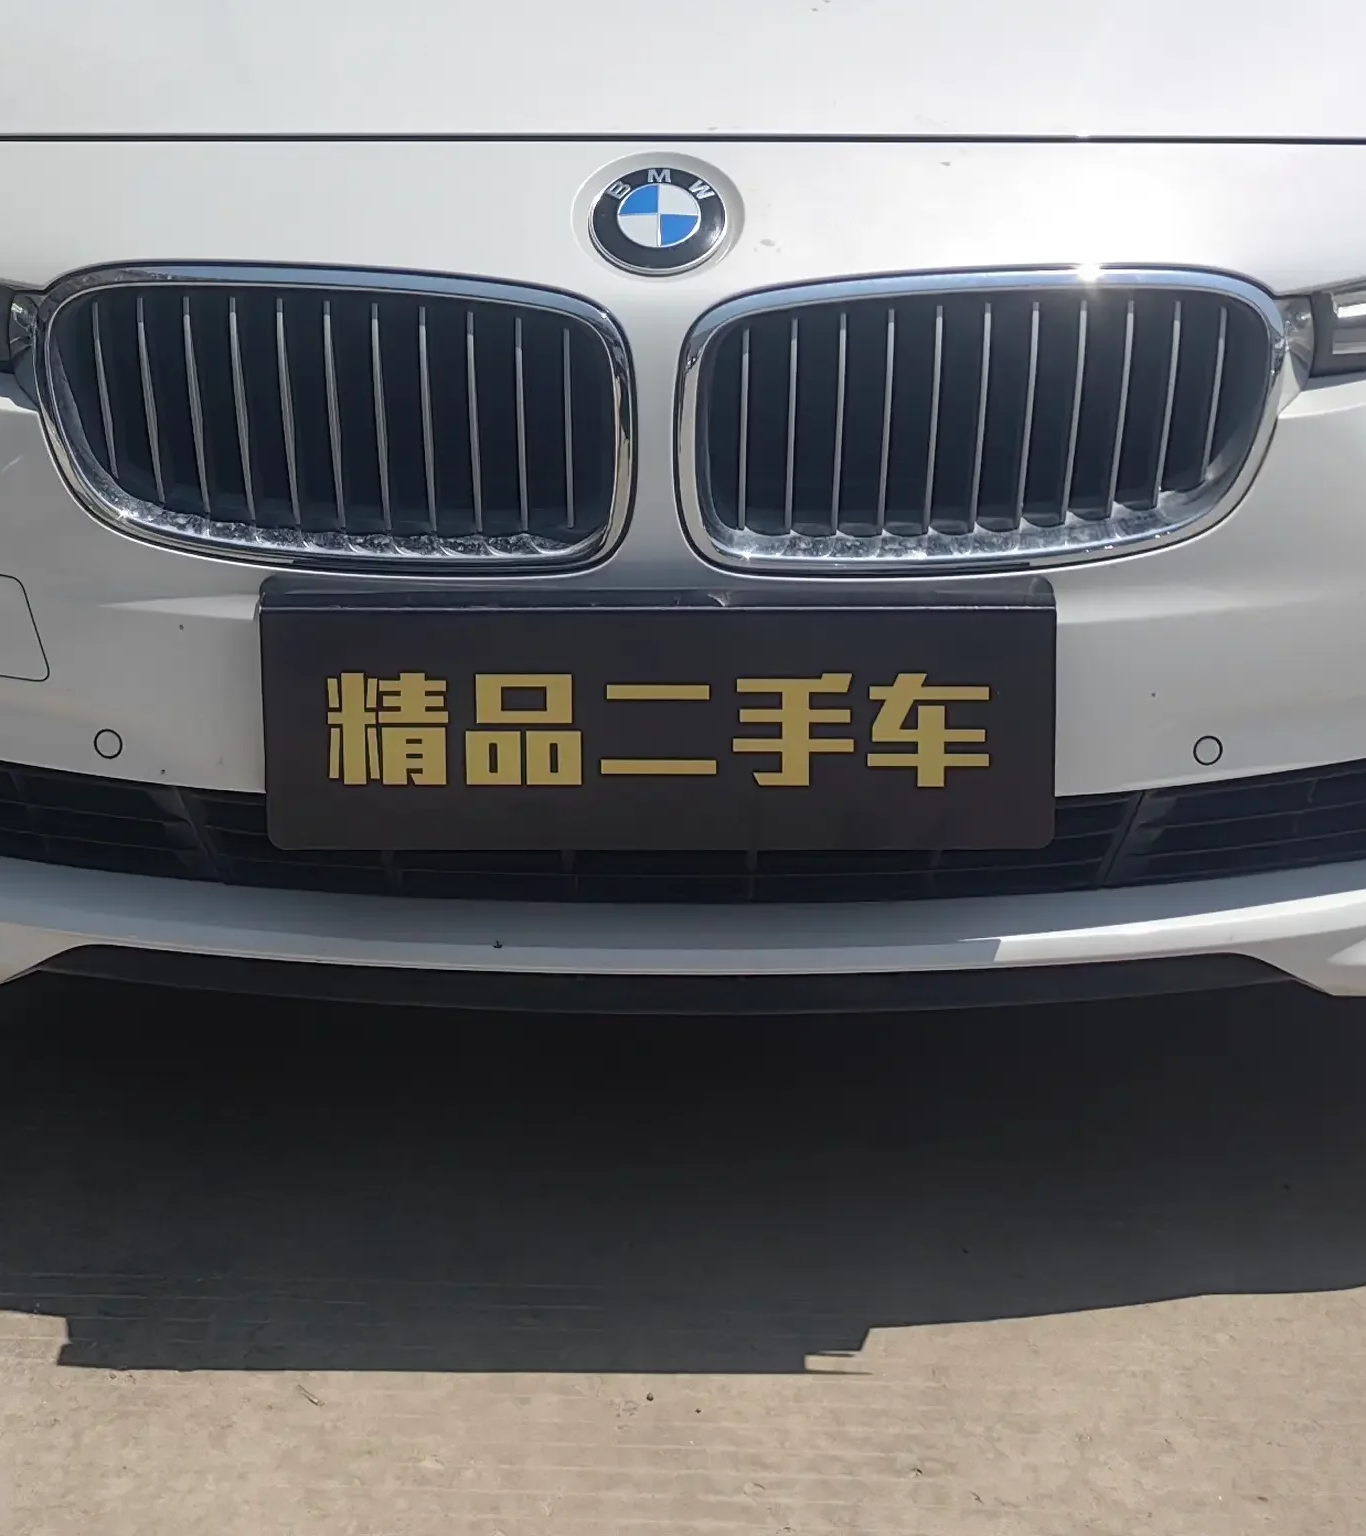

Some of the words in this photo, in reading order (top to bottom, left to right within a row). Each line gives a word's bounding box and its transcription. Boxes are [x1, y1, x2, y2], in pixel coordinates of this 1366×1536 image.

[605, 169, 715, 200] BMW
[327, 672, 989, 787] 精品二手车
